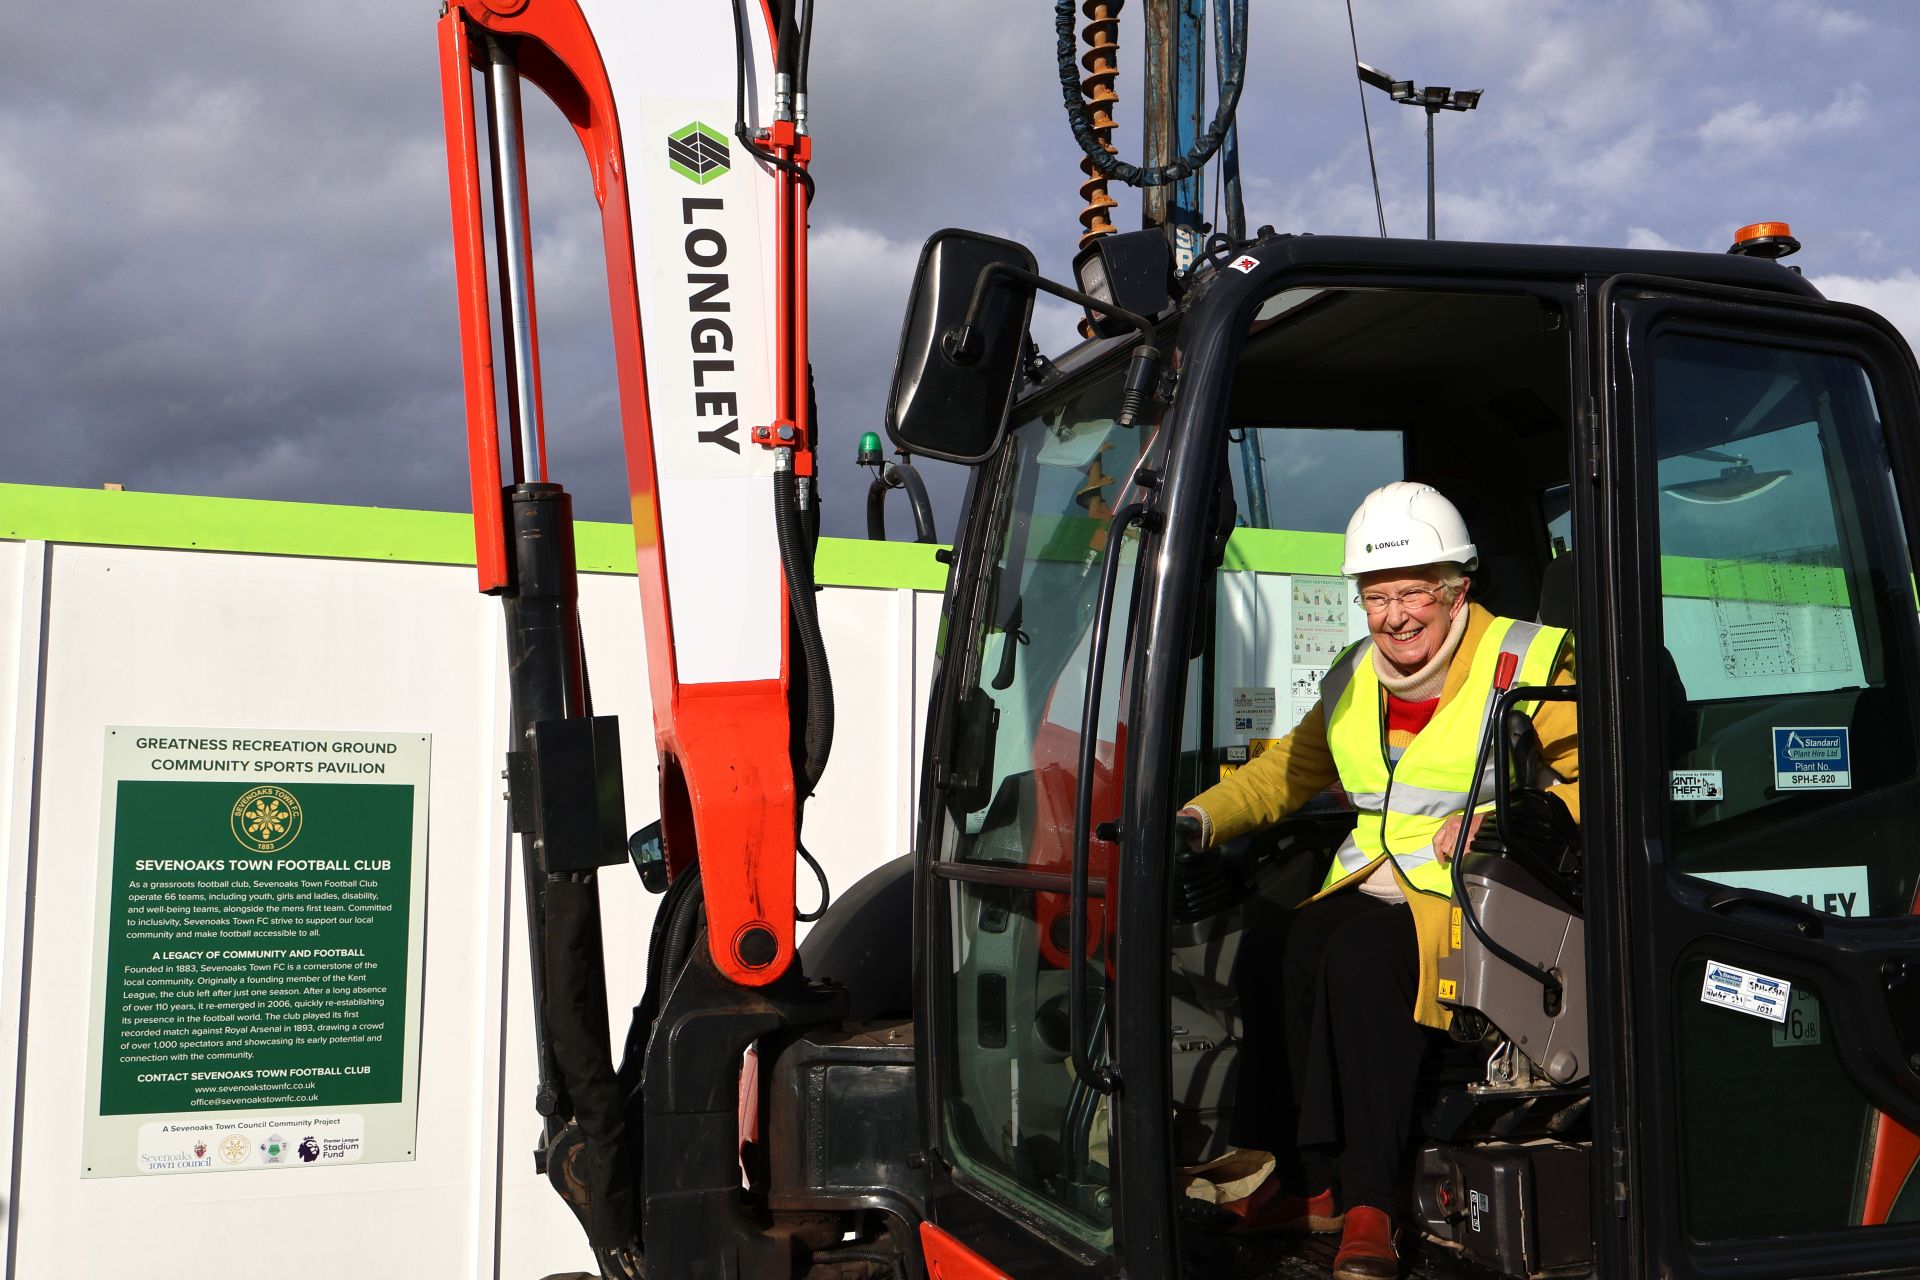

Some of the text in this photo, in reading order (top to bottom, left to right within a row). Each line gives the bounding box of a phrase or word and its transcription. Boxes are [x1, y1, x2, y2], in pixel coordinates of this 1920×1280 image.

[682, 197, 740, 455] LONGLEY
[1374, 539, 1410, 550] LONGLEY
[135, 737, 397, 754] GREATNESS RECREATION GROUND
[1804, 738, 1839, 748] Standard
[1793, 749, 1838, 758] Plant Hire Ltd
[150, 758, 385, 773] COMMUNITY SPORTS PAVILION
[1795, 762, 1831, 771] Plant No.
[1671, 777, 1697, 785] ANTI
[1792, 775, 1836, 784] SPH-E-920
[1670, 786, 1702, 794] THEFT
[235, 788, 273, 817] SEVENOAKS
[275, 789, 295, 806] TOWN
[135, 859, 391, 870] SEVENOAKS TOWN FOOTBALL CLUB
[149, 879, 378, 889] grassroots football club, Sevenoaks Town Football Club
[128, 891, 378, 902] operate 66 teams, including youth, girls ladies, disability,
[127, 905, 144, 913] and
[145, 905, 191, 914] well-being
[192, 905, 221, 913] teams,
[222, 904, 264, 914] alongside
[306, 904, 321, 912] first
[323, 904, 345, 912] team.
[347, 903, 392, 911] Committed
[137, 918, 181, 927] inclusivity,
[183, 917, 230, 925] Sevenoaks
[231, 917, 254, 925] Town
[256, 916, 269, 924] FC
[305, 916, 337, 925] support
[125, 930, 174, 939] community
[218, 929, 252, 937] football
[252, 929, 297, 937] accessible
[308, 928, 320, 936] all.
[151, 948, 365, 960] A LEGACY OF COMMUNITY AND FOOTBALL
[124, 962, 353, 973] Founded 1883, Sevenoaks Town FC cornerstone
[123, 973, 366, 986] local community. Originally founding member Kent
[122, 991, 158, 1000] League,
[175, 989, 195, 997] club
[196, 989, 210, 997] left
[211, 989, 232, 997] after
[232, 988, 249, 998] just
[302, 986, 324, 994] After
[332, 986, 351, 995] long
[351, 985, 387, 993] absence
[154, 1002, 169, 1010] 110
[169, 1003, 196, 1012] years,
[205, 1000, 256, 1010] re-emerged
[266, 999, 292, 1008] 2006,
[293, 999, 324, 1008] quickly
[325, 997, 384, 1006] re-establishing
[133, 1010, 359, 1025] presence football world. The club played first
[120, 1022, 384, 1037] recorded match against Royal Arsenal 1893, drawing crowd
[153, 1040, 177, 1049] 1,000
[179, 1039, 224, 1049] spectators
[225, 1038, 242, 1046] and
[243, 1037, 293, 1046] showcasing
[306, 1035, 327, 1045] early
[329, 1034, 364, 1044] potential
[366, 1034, 382, 1042] and
[119, 1050, 254, 1062] connection with community.
[136, 1065, 371, 1082] CONTACT SEVENOAKS TOWN FOOTBALL CLUB
[194, 1081, 316, 1093] www.sevenoakstownfc.co.uk
[189, 1093, 318, 1106] office@sevenoakstownfc.co.uk
[170, 1123, 213, 1132] Sevenoaks
[237, 1121, 266, 1129] Council
[268, 1119, 312, 1127] Community
[313, 1118, 340, 1126] Project
[323, 1143, 359, 1151] Stadium
[141, 1151, 192, 1163] Sevenoaks
